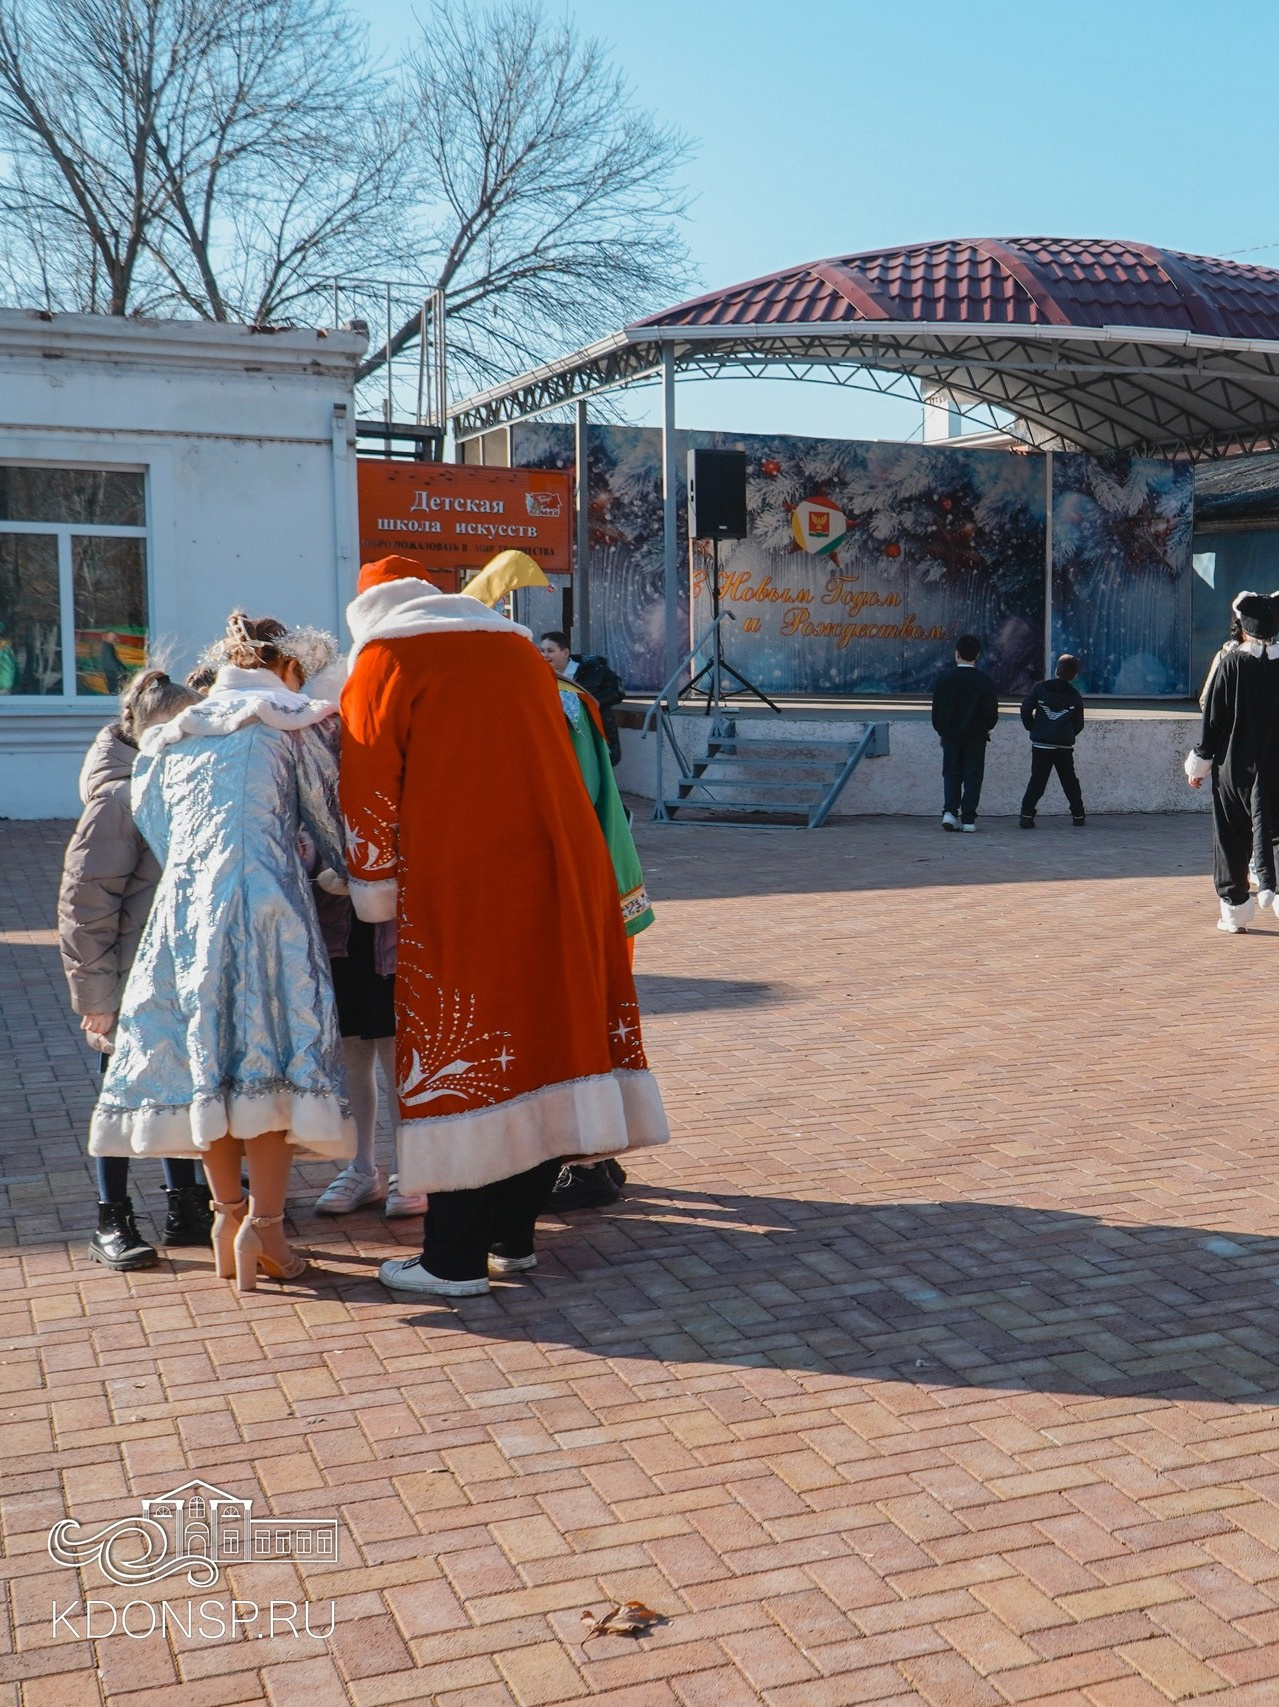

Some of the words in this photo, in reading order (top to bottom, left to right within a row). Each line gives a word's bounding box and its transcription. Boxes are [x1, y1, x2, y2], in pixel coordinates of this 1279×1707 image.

[410, 490, 505, 514] Детская
[377, 518, 442, 534] школа
[455, 522, 538, 540] искусств
[717, 570, 814, 605] Новым
[822, 575, 902, 618] Годом
[743, 617, 762, 633] и
[780, 607, 958, 650] Рождеством!
